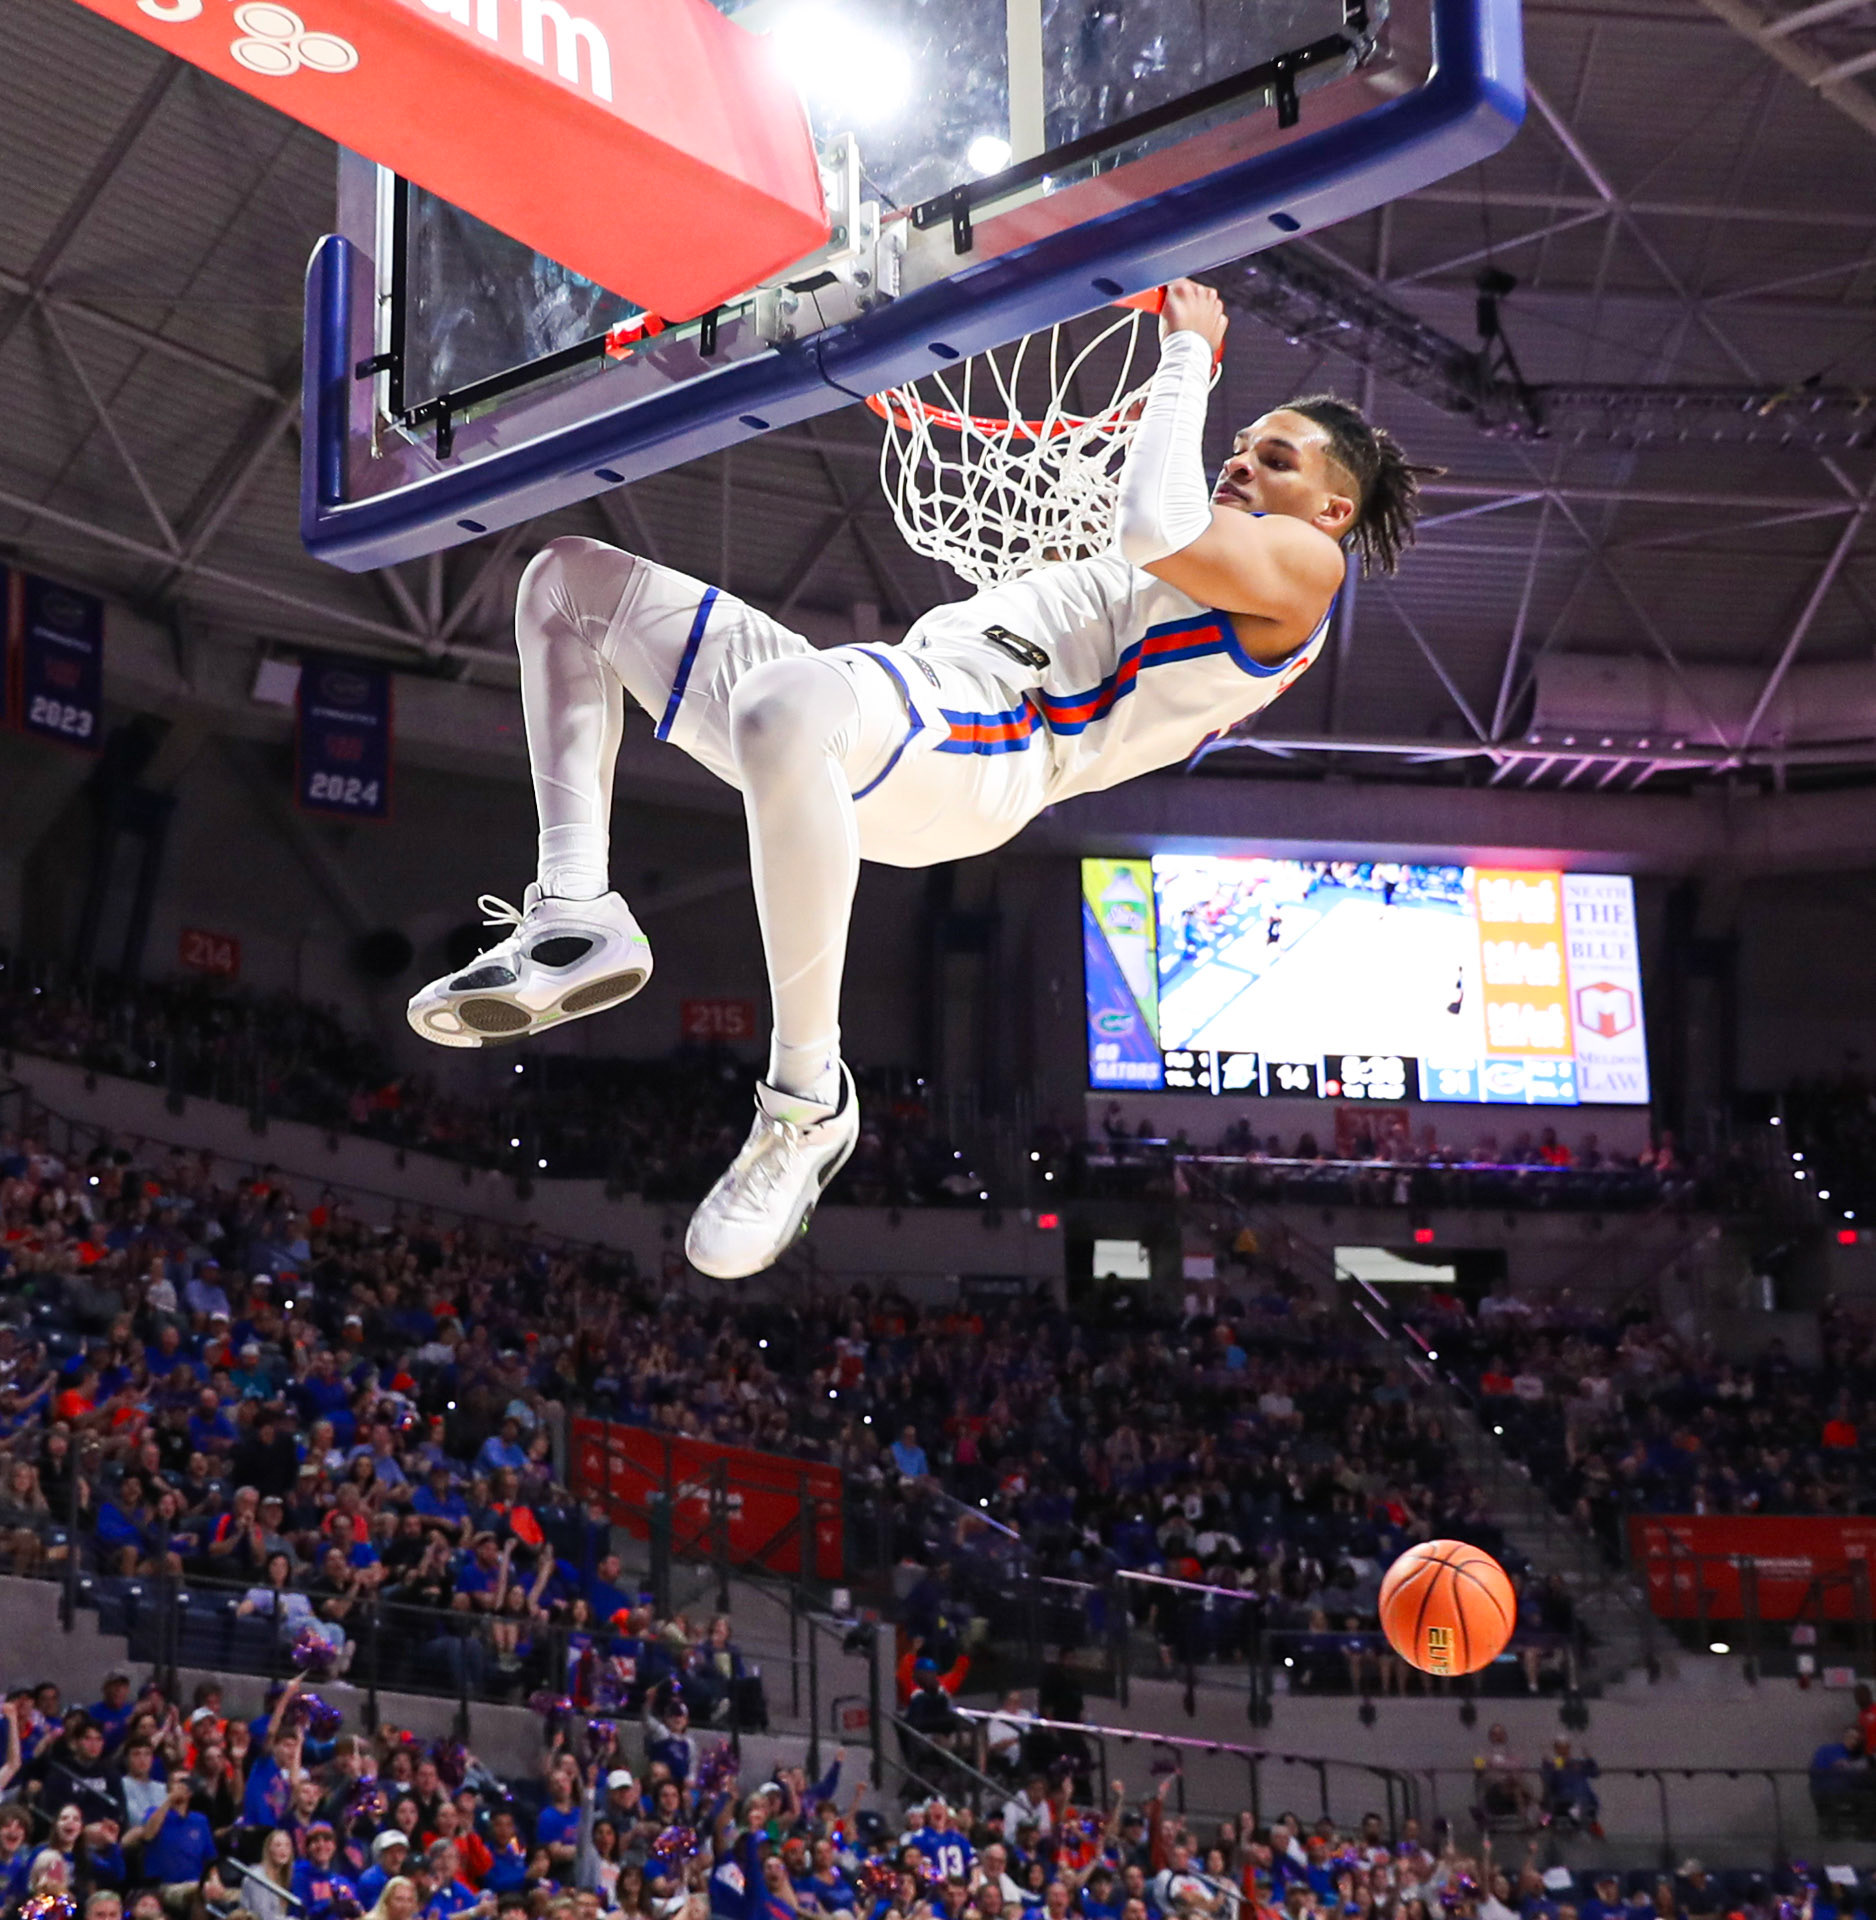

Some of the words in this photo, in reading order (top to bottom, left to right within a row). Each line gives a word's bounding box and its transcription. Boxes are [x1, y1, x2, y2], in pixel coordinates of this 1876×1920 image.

[30, 694, 94, 738] 2023
[308, 770, 378, 808] 2024
[1567, 902, 1630, 924] THE
[1571, 942, 1632, 960] BLUE
[689, 1005, 745, 1033] 215
[1582, 1066, 1640, 1091] LAW
[938, 1844, 964, 1877] 13
